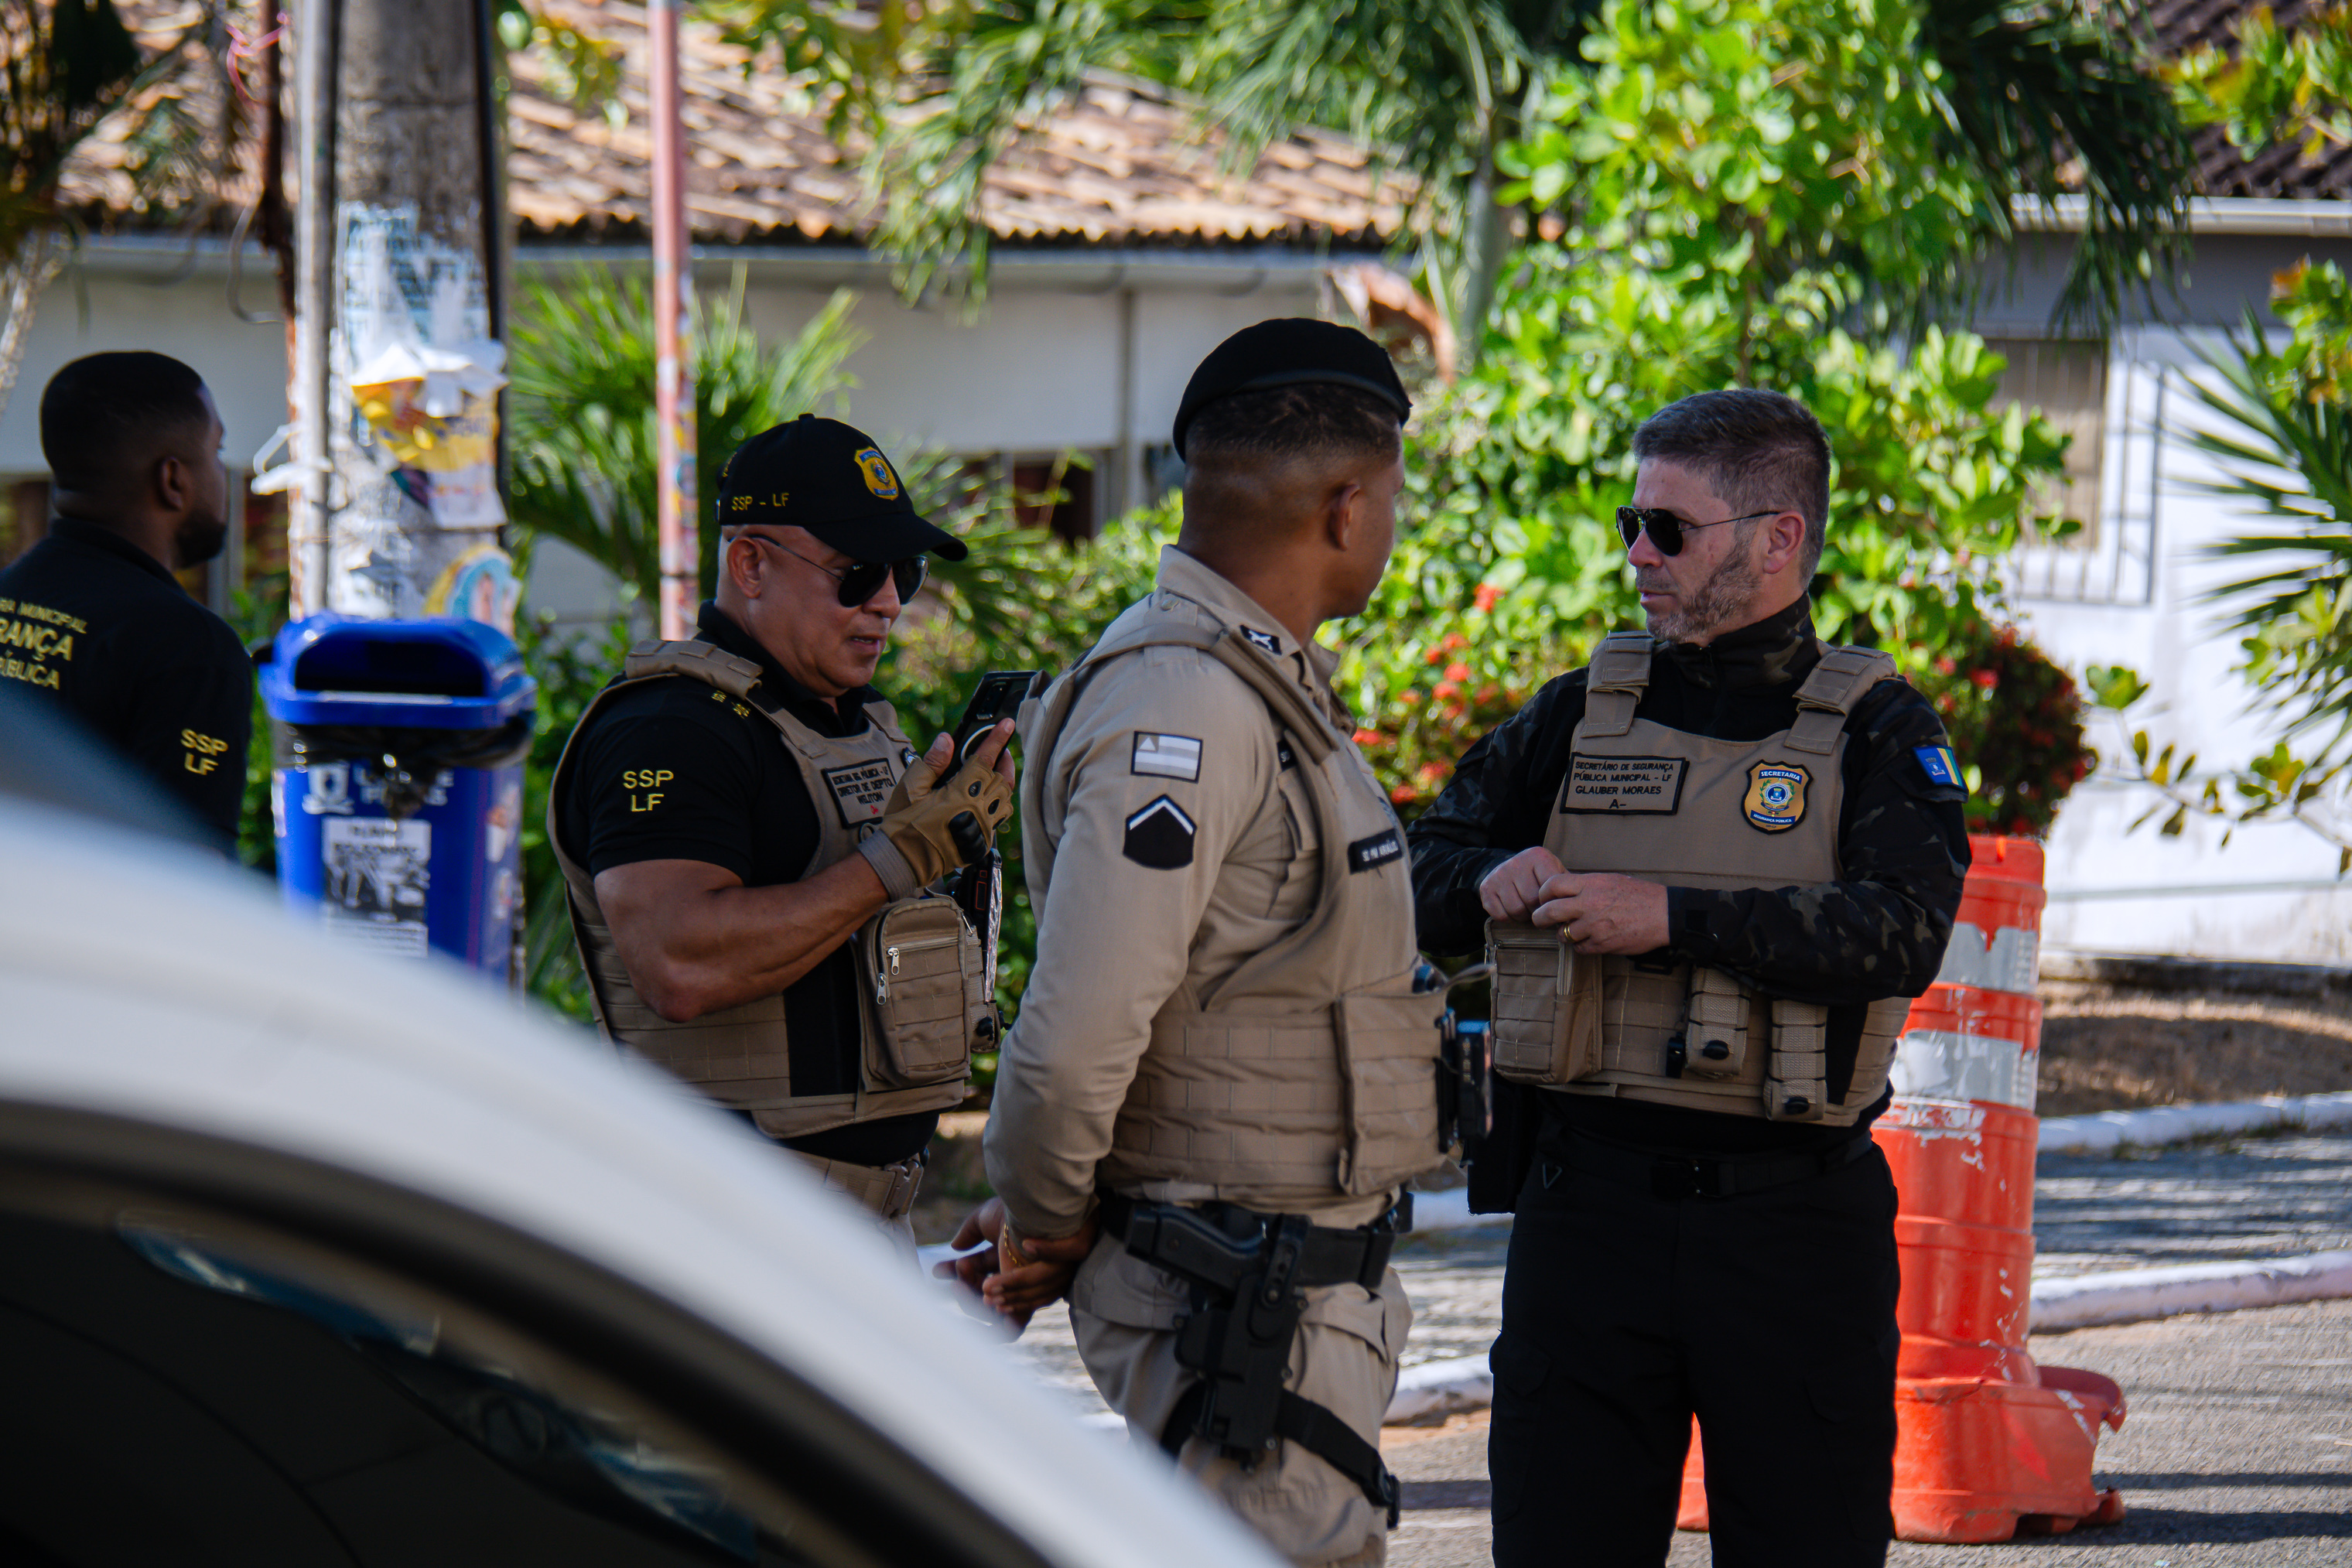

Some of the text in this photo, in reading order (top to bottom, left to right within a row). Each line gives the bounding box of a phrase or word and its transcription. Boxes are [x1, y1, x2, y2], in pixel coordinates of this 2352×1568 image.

[731, 496, 753, 511] SSP
[772, 492, 790, 507] LF
[180, 728, 229, 756] SSP
[184, 752, 219, 776] LF
[1575, 760, 1618, 770] SECRETÁRIO
[1632, 763, 1673, 773] SEGURANÇA
[622, 769, 674, 789] SSP
[1574, 770, 1607, 781] PÚBLICA
[1761, 770, 1800, 781] SECRETARIA
[1575, 785, 1662, 794] GLAUBER MORAES
[631, 793, 665, 812] LF
